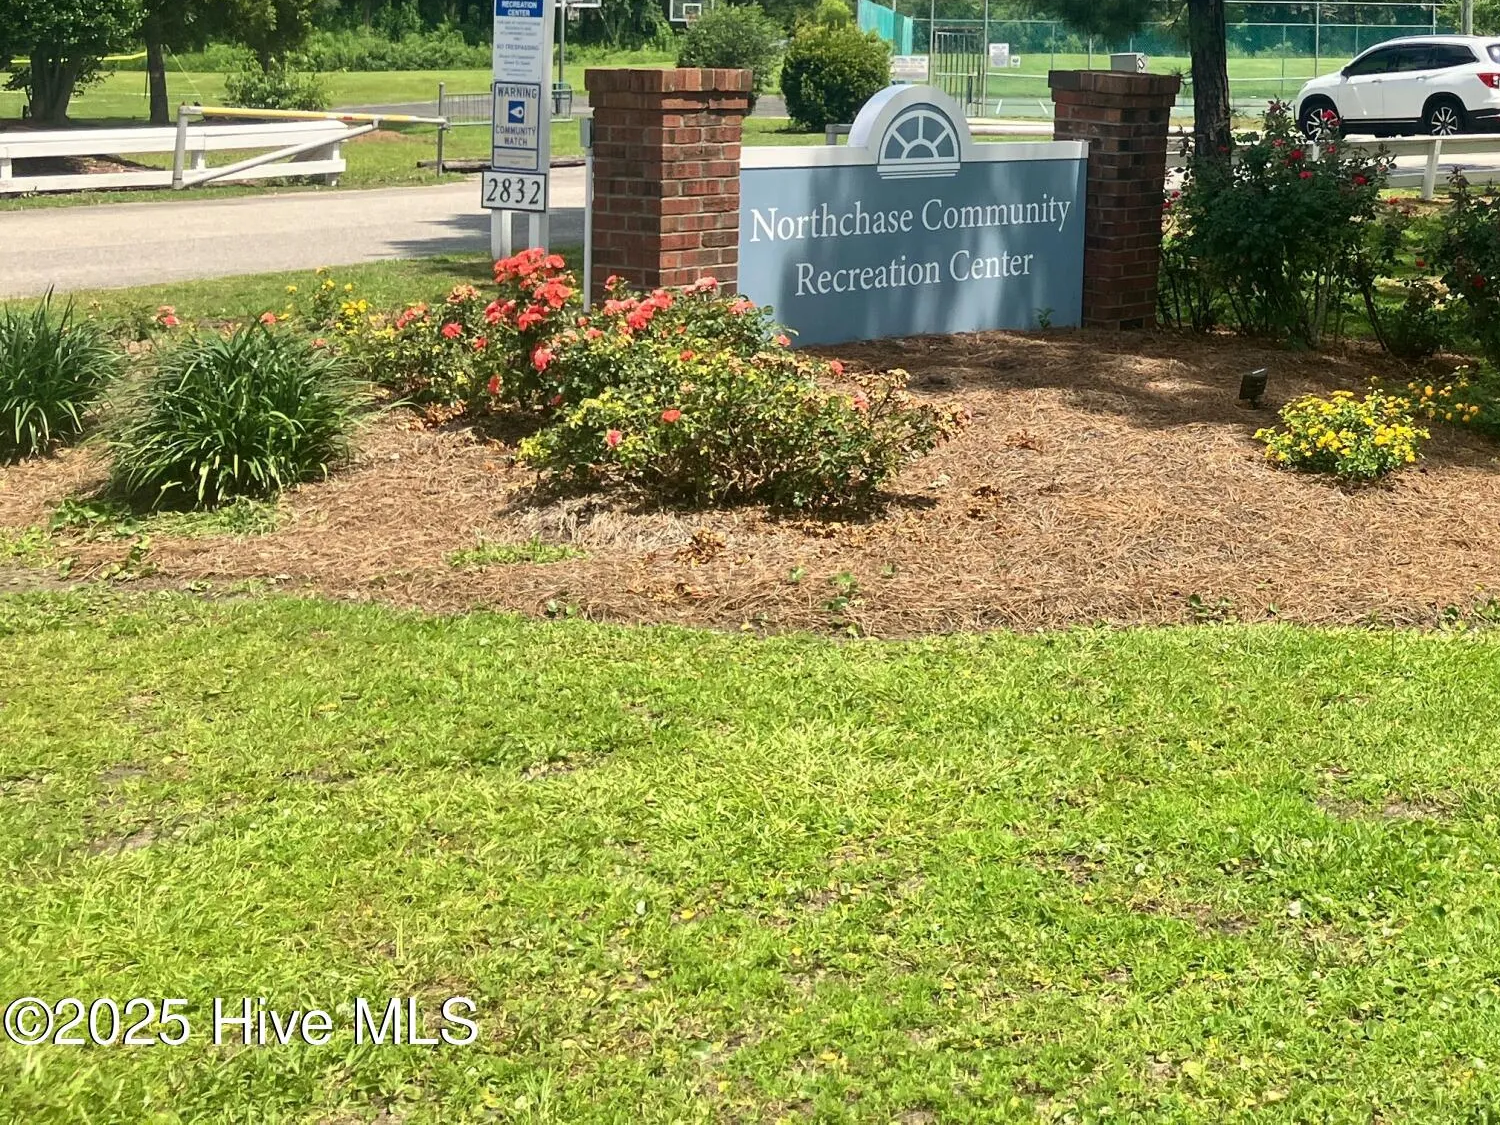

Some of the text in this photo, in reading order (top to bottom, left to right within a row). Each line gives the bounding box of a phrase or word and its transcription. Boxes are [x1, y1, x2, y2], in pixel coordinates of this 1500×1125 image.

[501, 1, 537, 9] RECREATION
[497, 87, 537, 99] WARNING
[496, 125, 536, 136] COMMUNITY
[504, 136, 528, 146] WATCH
[486, 178, 541, 205] 2832
[749, 192, 1072, 242] Northchase Community
[795, 249, 1034, 296] Recreation Center
